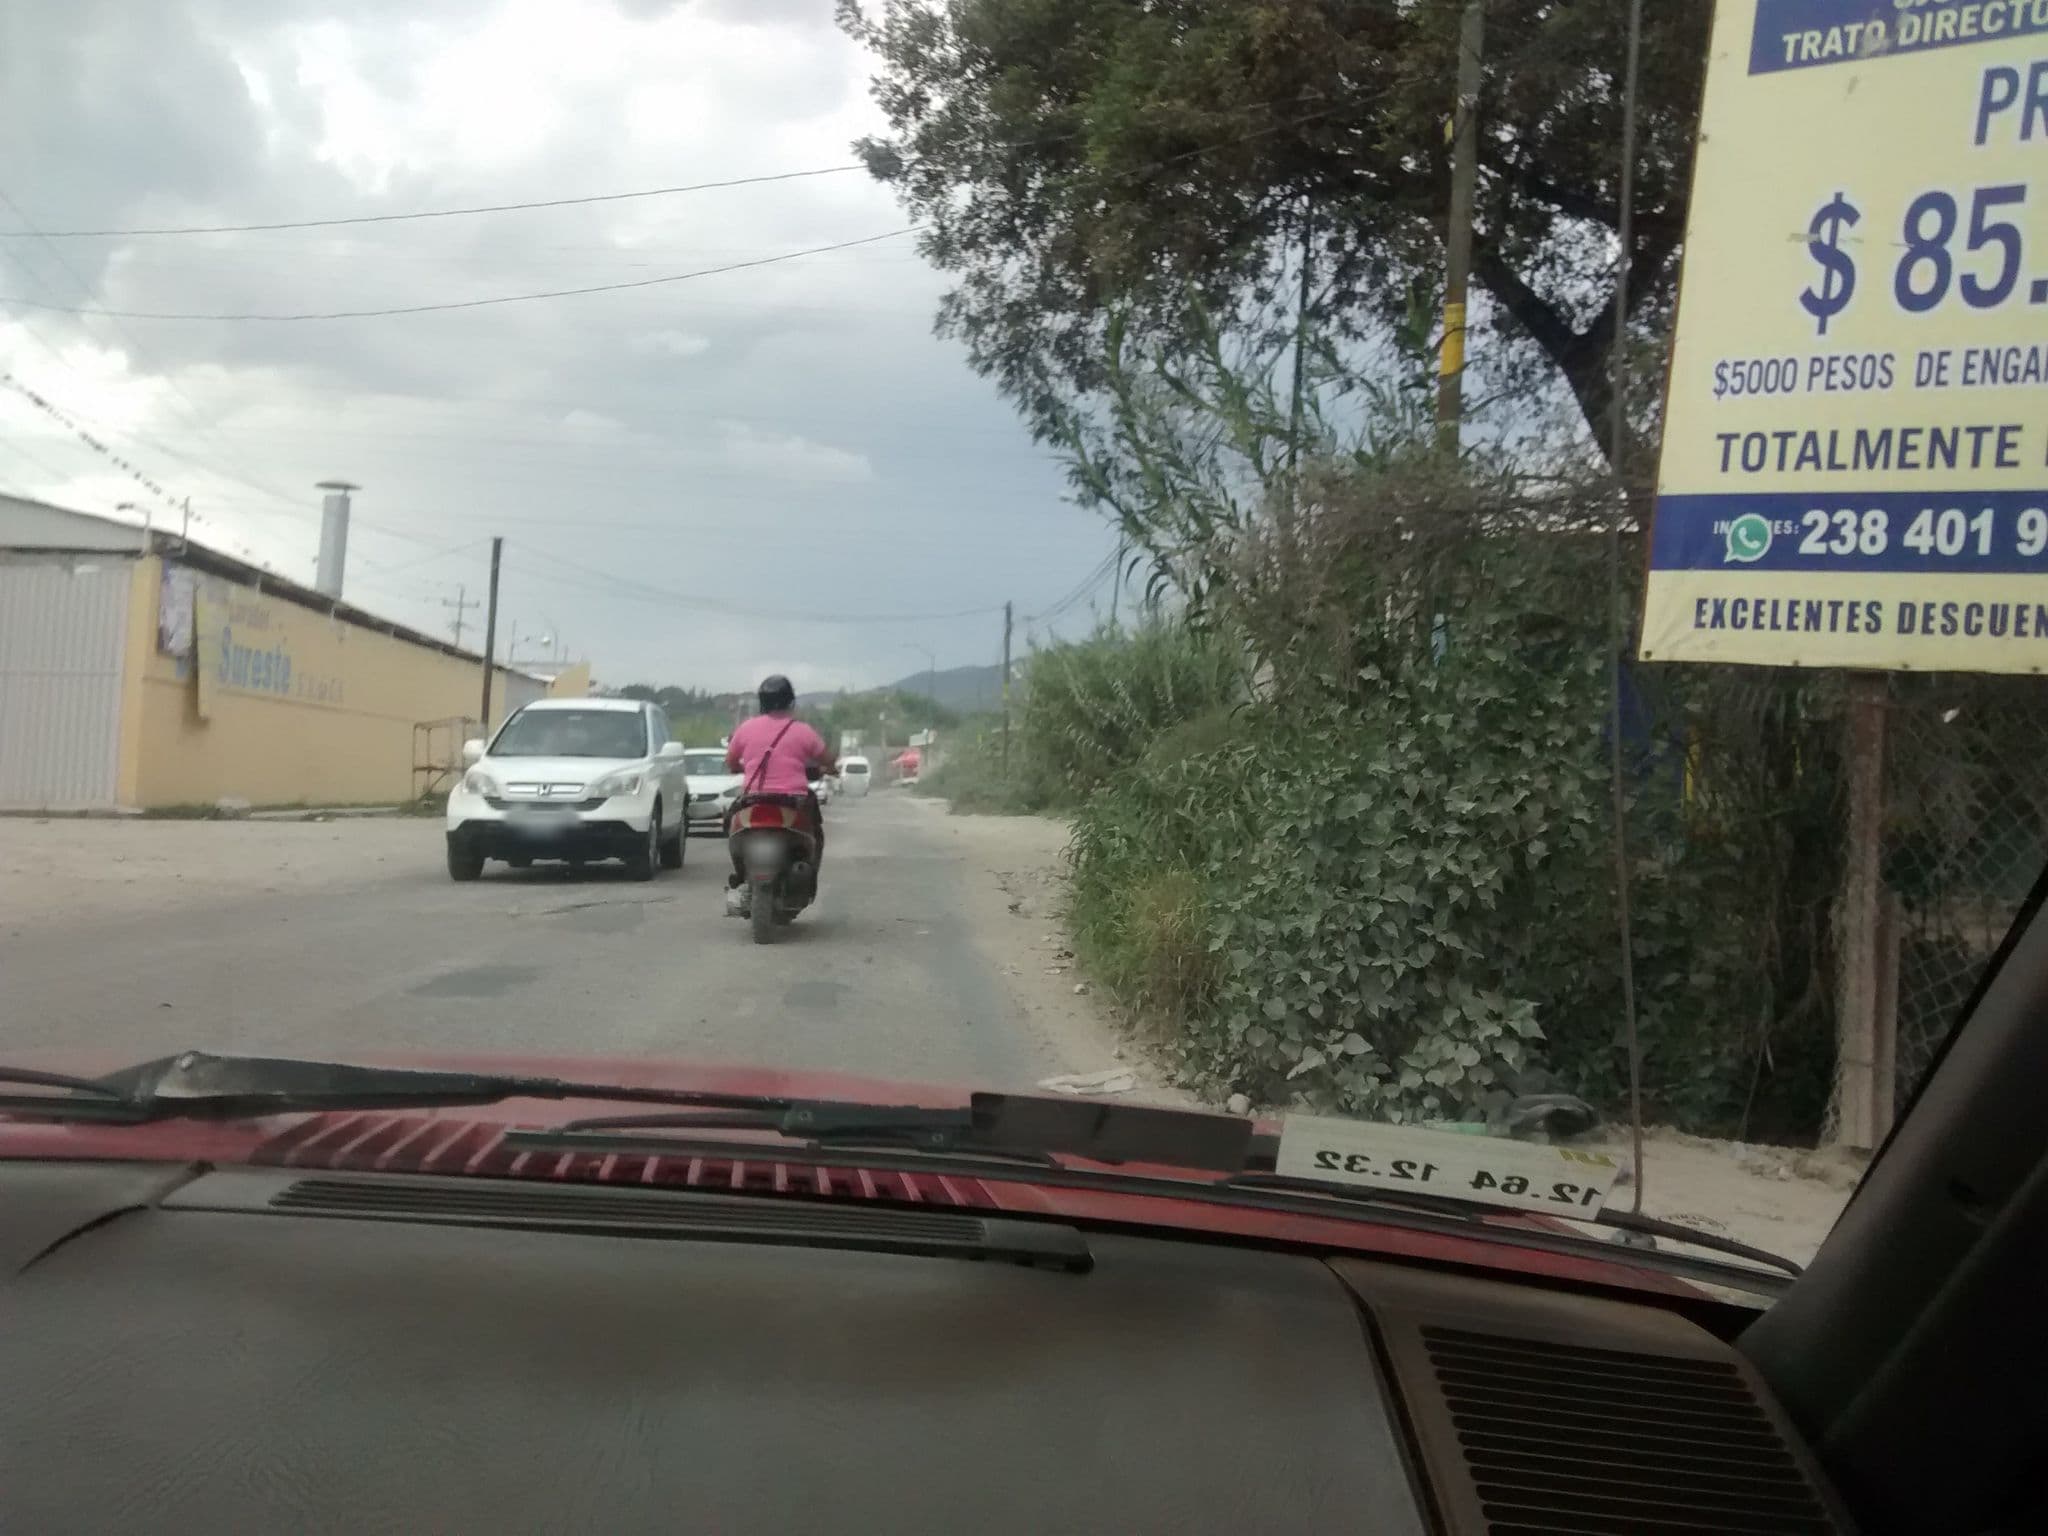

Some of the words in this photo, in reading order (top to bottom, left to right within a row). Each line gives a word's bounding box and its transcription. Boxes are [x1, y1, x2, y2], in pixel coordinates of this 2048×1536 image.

[1782, 20, 1887, 63] TRATO
[1799, 192, 1860, 335] $
[1713, 357, 1797, 400] $5000
[1806, 353, 1895, 392] PESOS
[1915, 350, 1951, 387] DE
[1961, 345, 2048, 386] ENGA
[1716, 424, 2023, 473] TOTALMENTE
[1799, 508, 1889, 556] 238
[1903, 507, 1994, 556] 401
[1694, 597, 1882, 633] EXCELENTES
